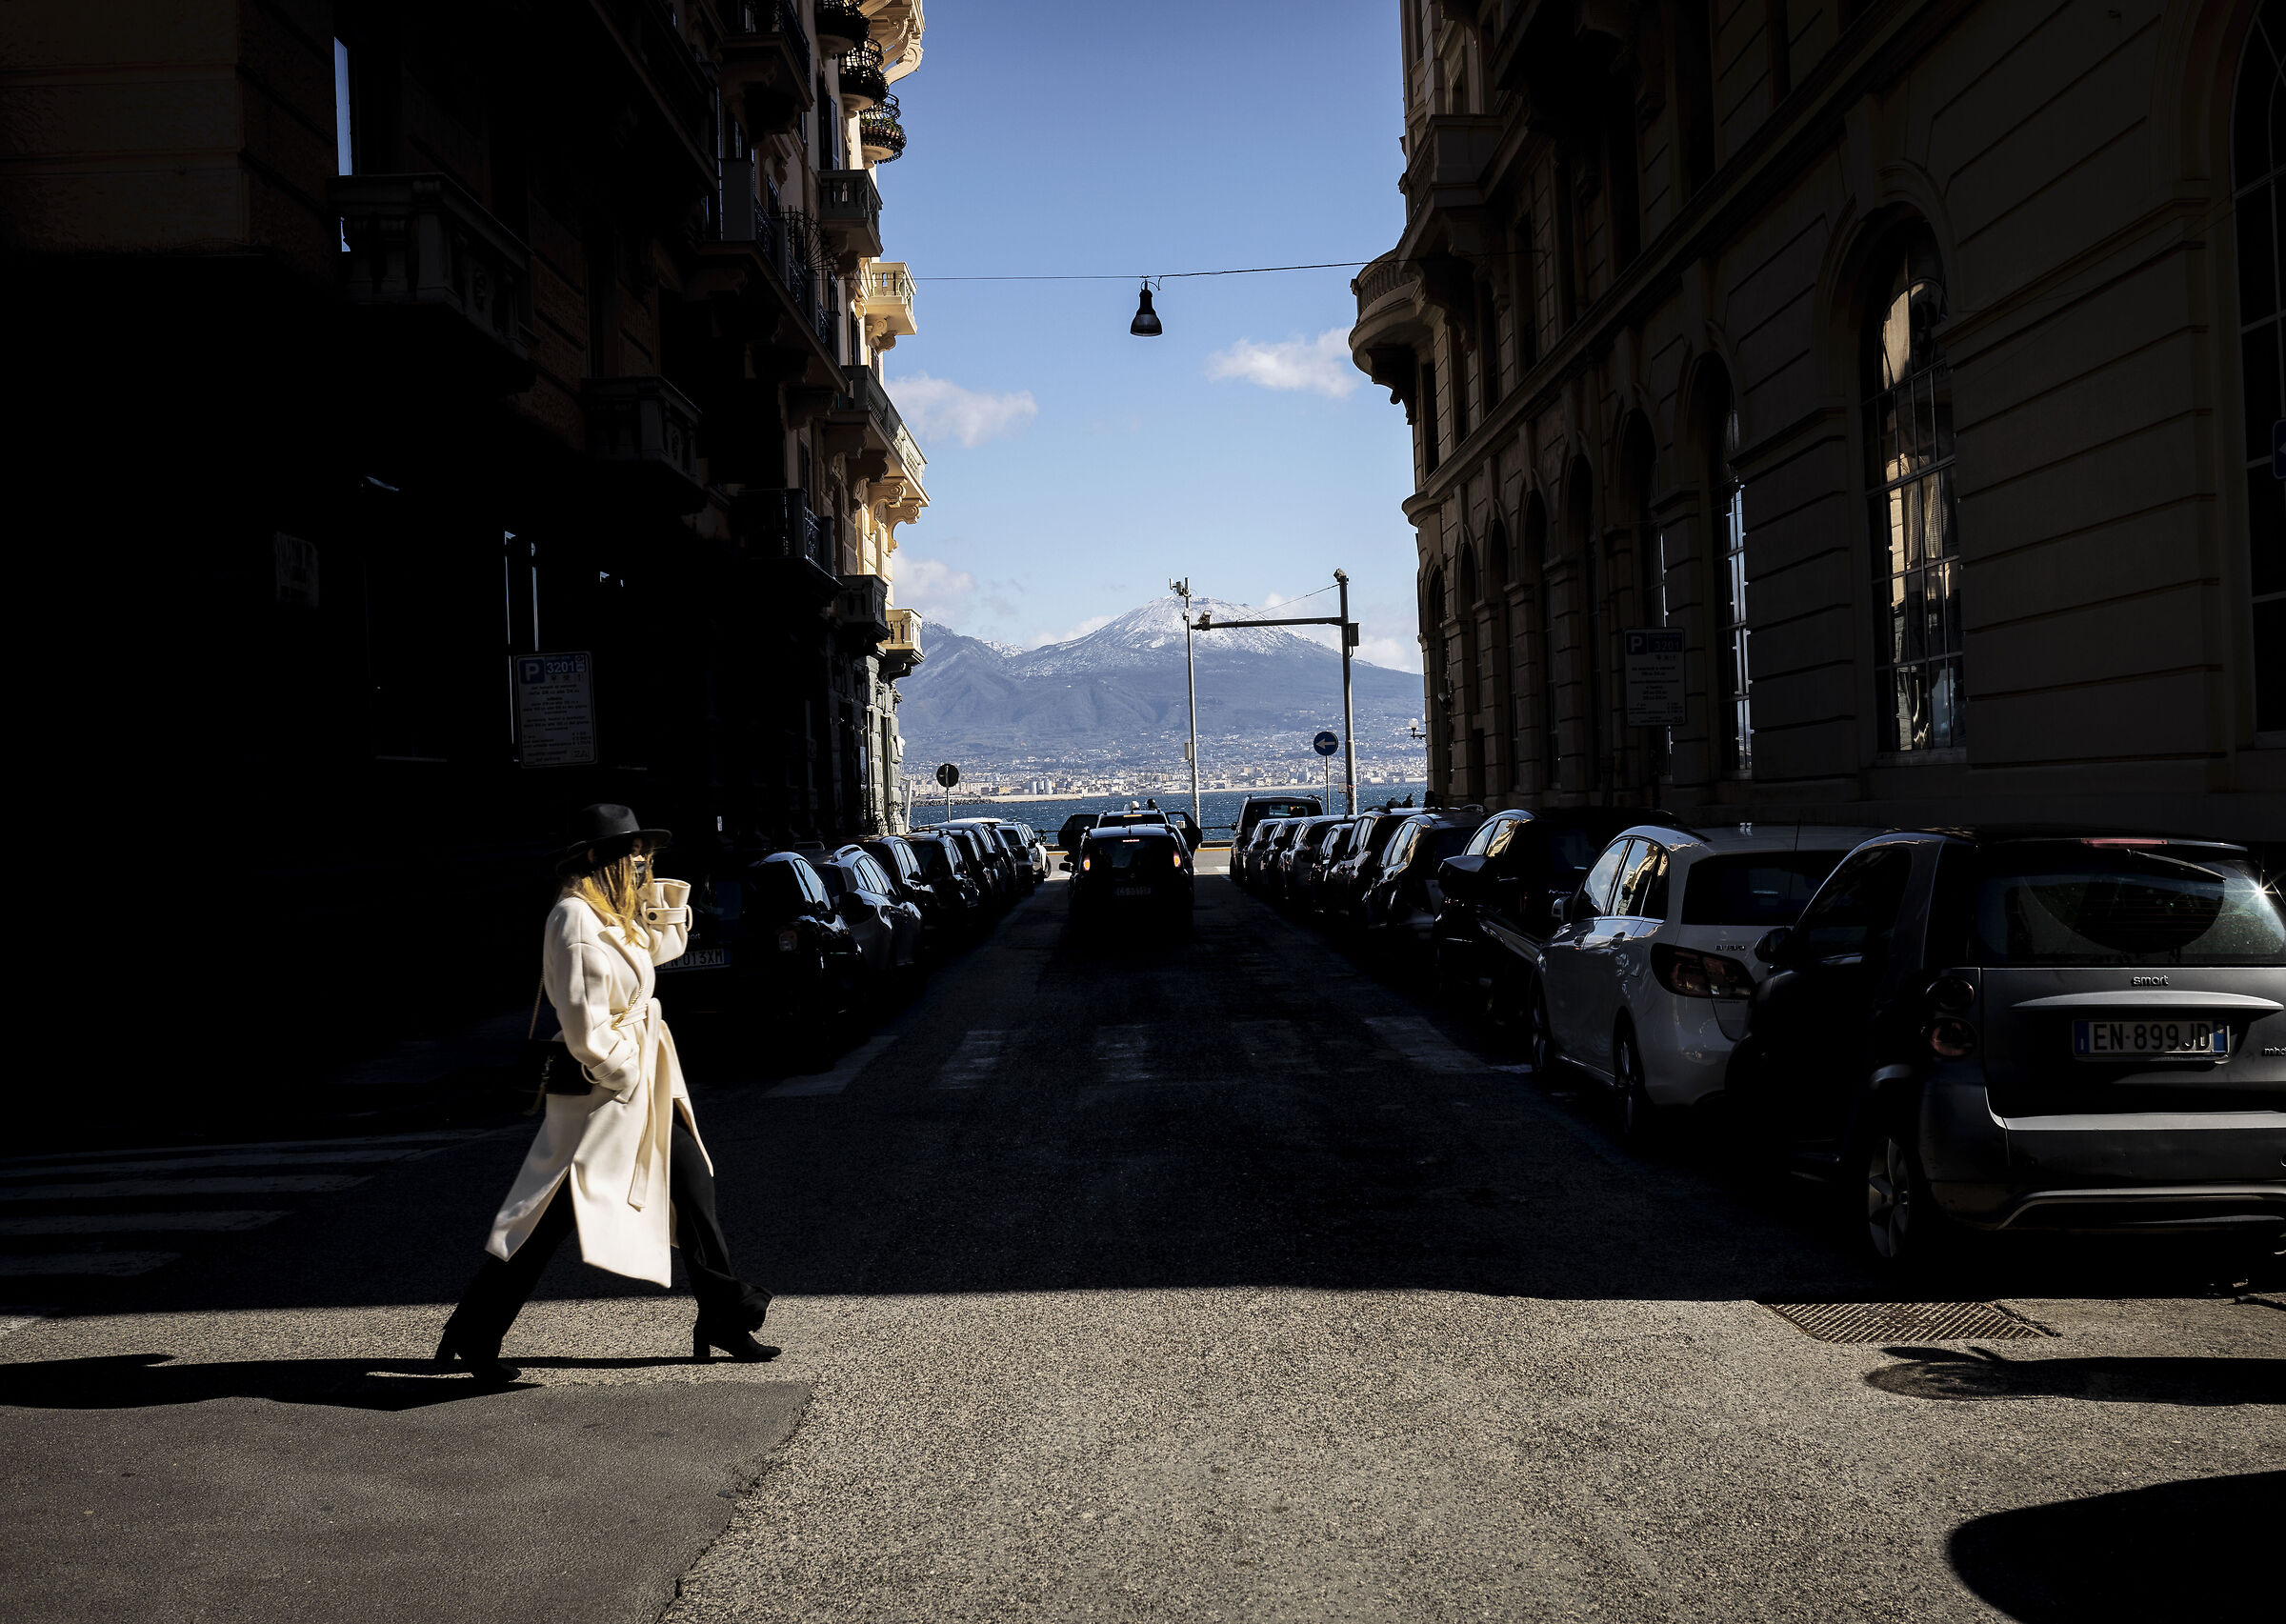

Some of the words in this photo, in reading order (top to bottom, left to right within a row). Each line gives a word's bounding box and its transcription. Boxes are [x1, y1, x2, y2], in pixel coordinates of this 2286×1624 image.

[1630, 635, 1644, 652] P
[525, 663, 540, 682] P
[546, 660, 575, 673] 3201
[2133, 974, 2169, 985] smart
